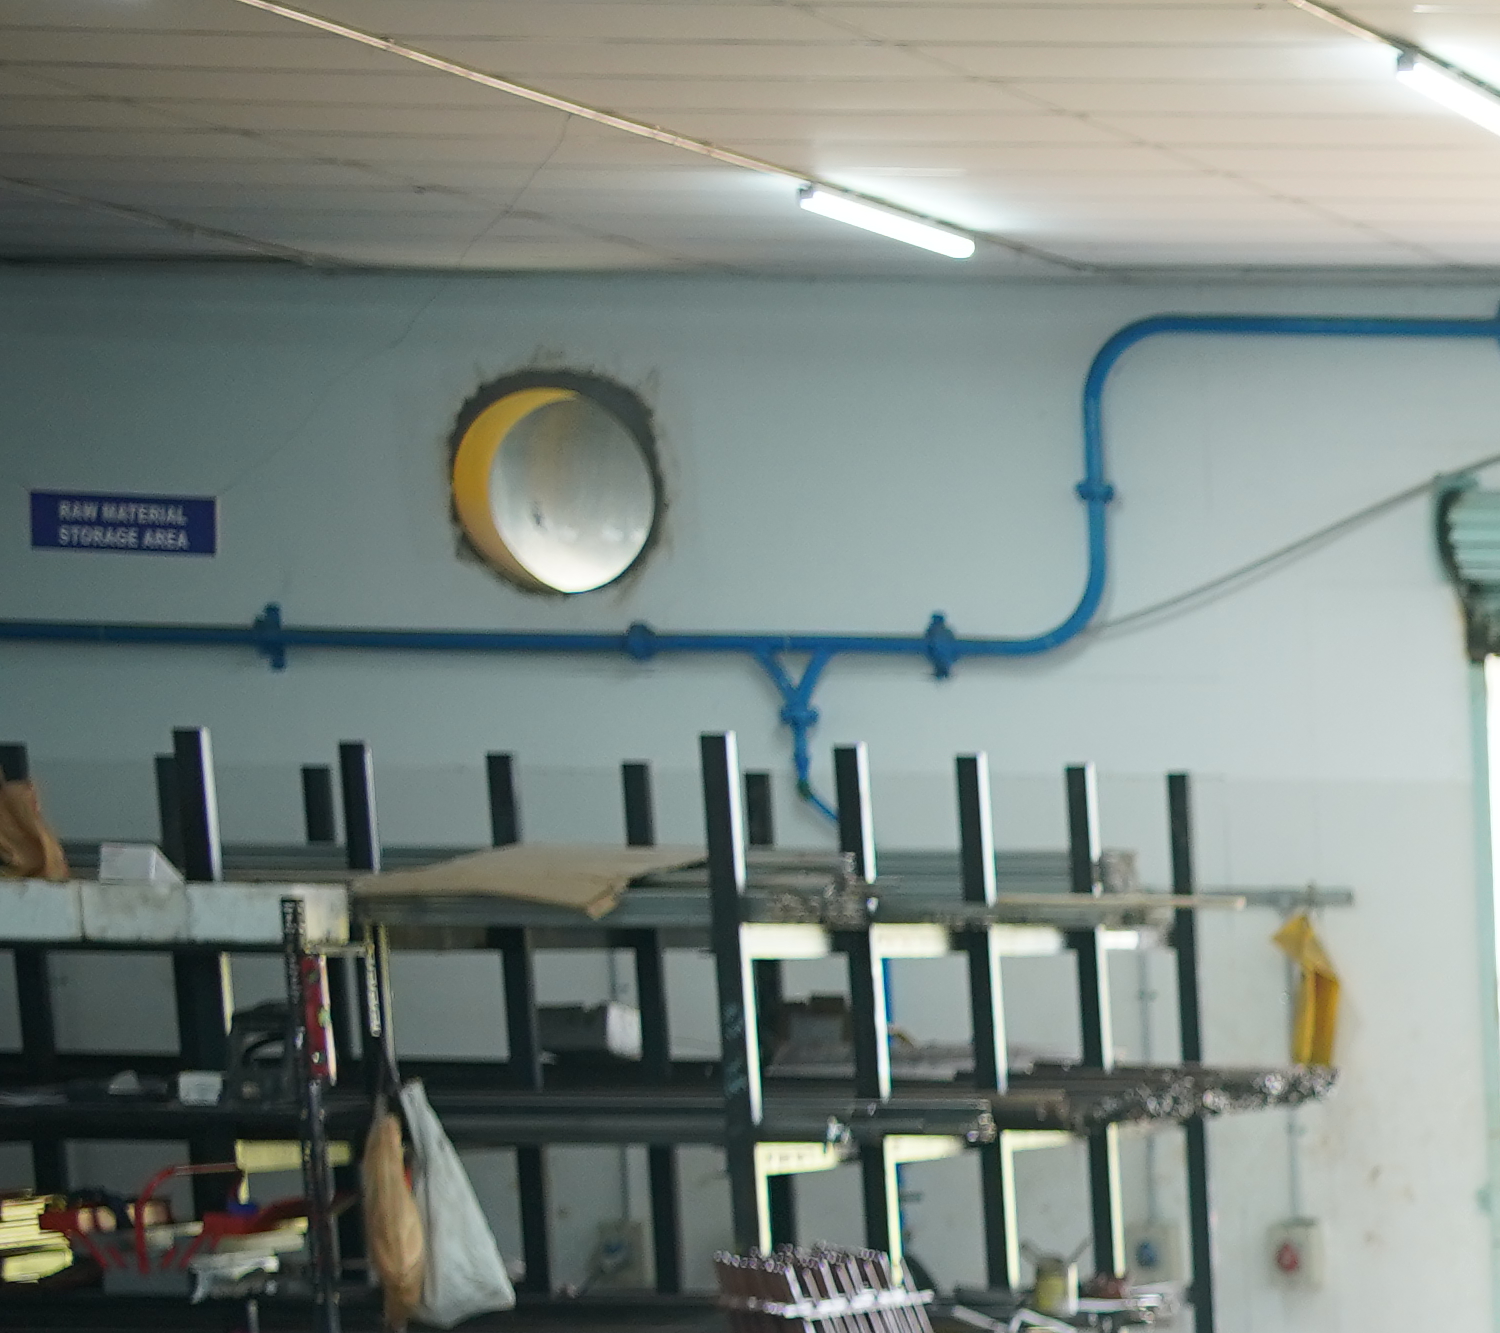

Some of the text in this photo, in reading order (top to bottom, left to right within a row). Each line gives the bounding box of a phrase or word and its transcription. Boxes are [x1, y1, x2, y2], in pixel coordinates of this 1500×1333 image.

[59, 501, 188, 526] RAW MATERIAL
[59, 524, 190, 549] STORAGE AREA
